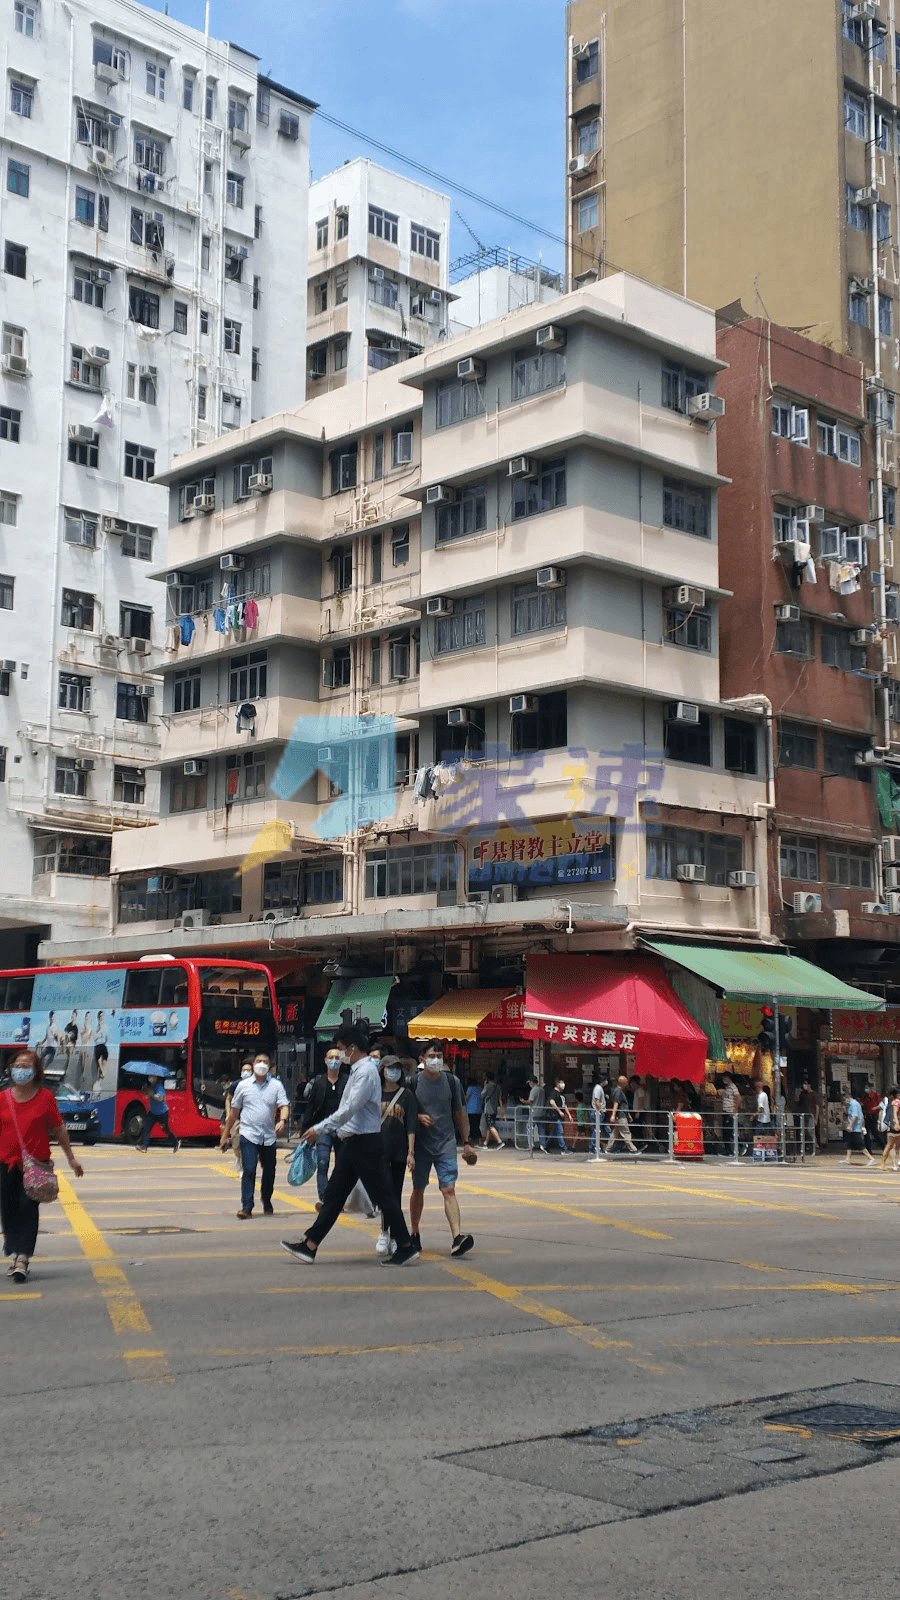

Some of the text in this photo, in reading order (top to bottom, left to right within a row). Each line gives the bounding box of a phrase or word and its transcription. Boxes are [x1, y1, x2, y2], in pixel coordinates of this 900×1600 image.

[566, 866, 602, 877] 27207431
[243, 1021, 260, 1035] 118
[544, 1022, 636, 1050] 中英找換店
